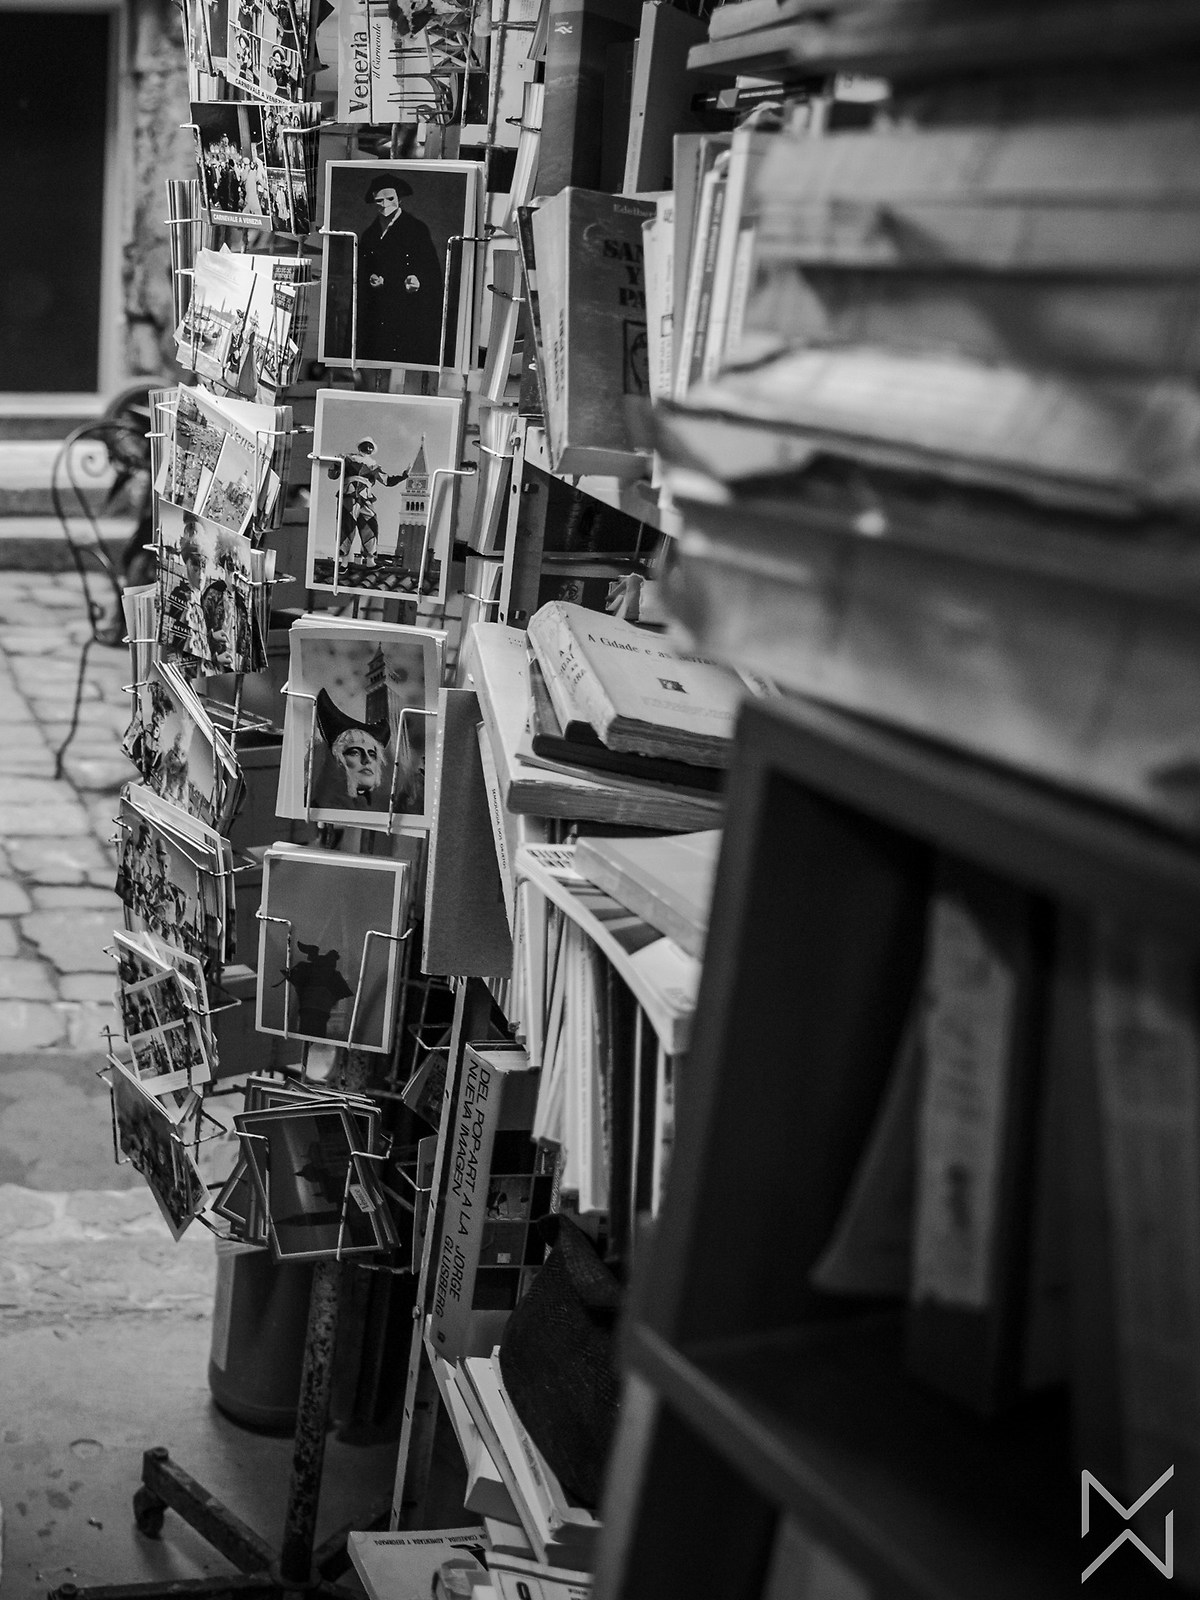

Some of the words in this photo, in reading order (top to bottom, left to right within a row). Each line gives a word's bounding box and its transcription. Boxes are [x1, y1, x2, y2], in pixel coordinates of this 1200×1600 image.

[349, 30, 368, 114] Venezia
[213, 213, 239, 224] CARNEVALE
[587, 633, 597, 645] A
[600, 636, 639, 654] Cidade
[461, 1058, 480, 1119] NUEVA
[478, 1065, 492, 1098] DEL
[452, 1119, 468, 1197] IMAGEN
[464, 1105, 487, 1195] POP-ART
[435, 1236, 455, 1318] GLUSBERG
[449, 1244, 466, 1302] JORGE
